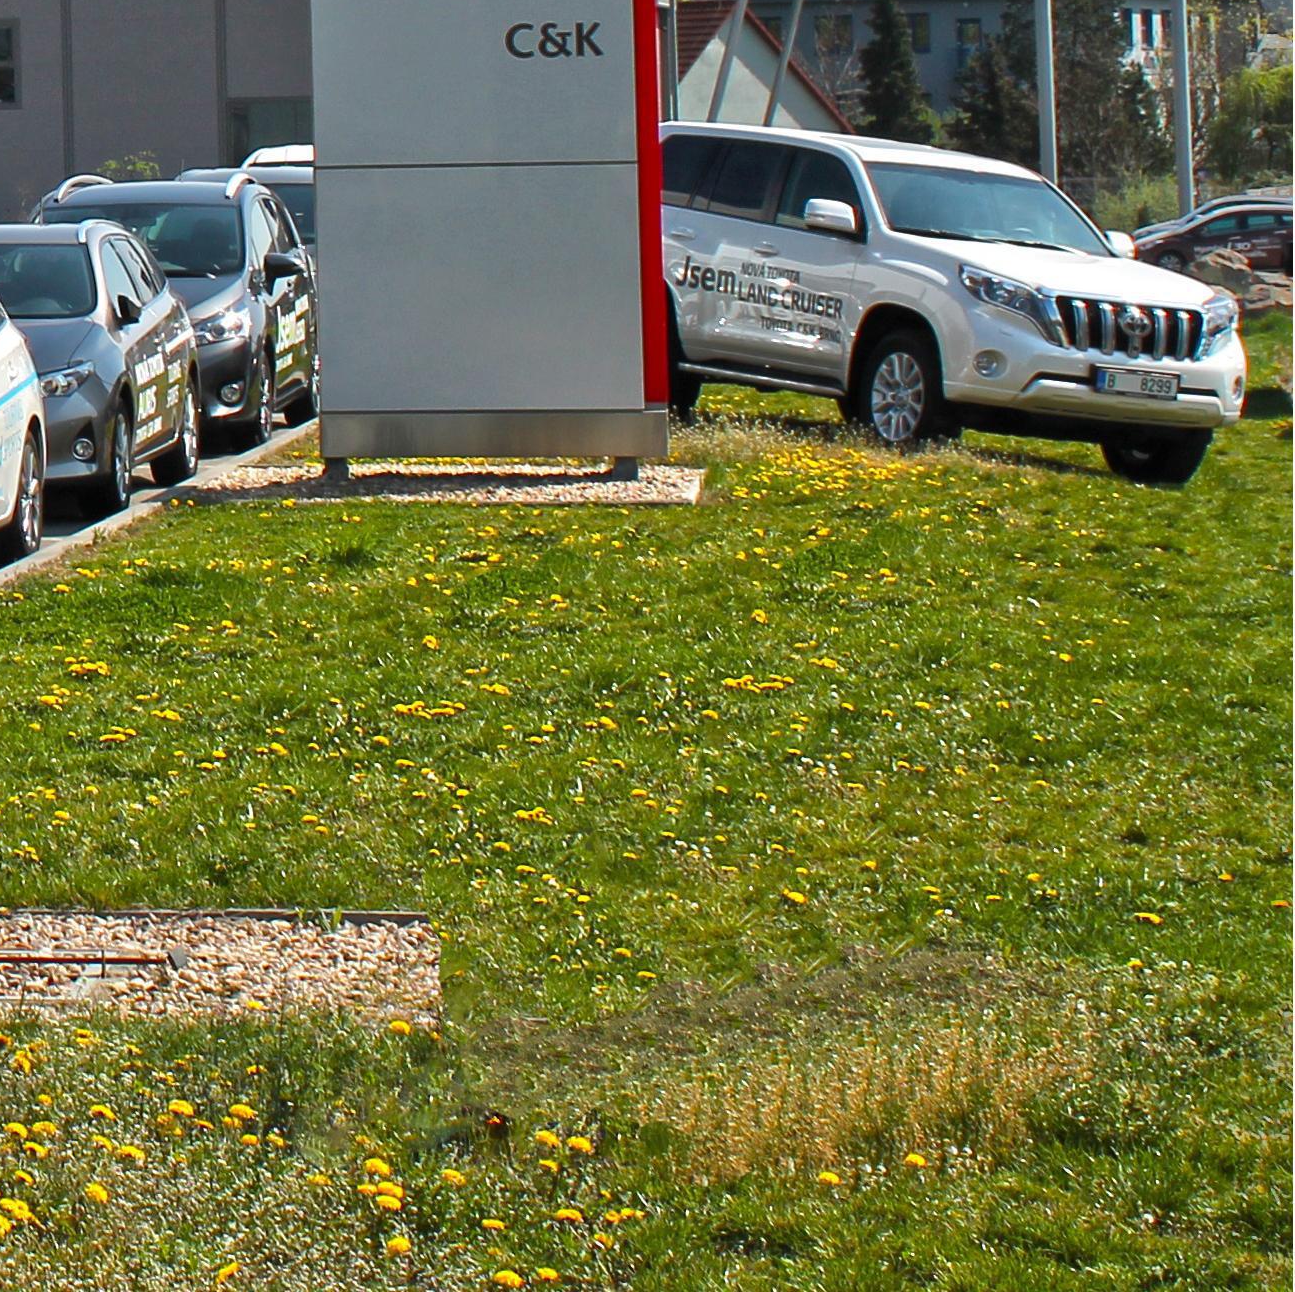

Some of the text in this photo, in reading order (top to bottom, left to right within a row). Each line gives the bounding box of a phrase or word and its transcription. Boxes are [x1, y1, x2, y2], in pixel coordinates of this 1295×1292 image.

[504, 21, 605, 59] C&K
[675, 256, 736, 295] Jsem
[740, 261, 800, 284] NOVÁ TOYOTA
[737, 281, 843, 320] LAND CRUISER
[1107, 373, 1172, 395] B 8299
